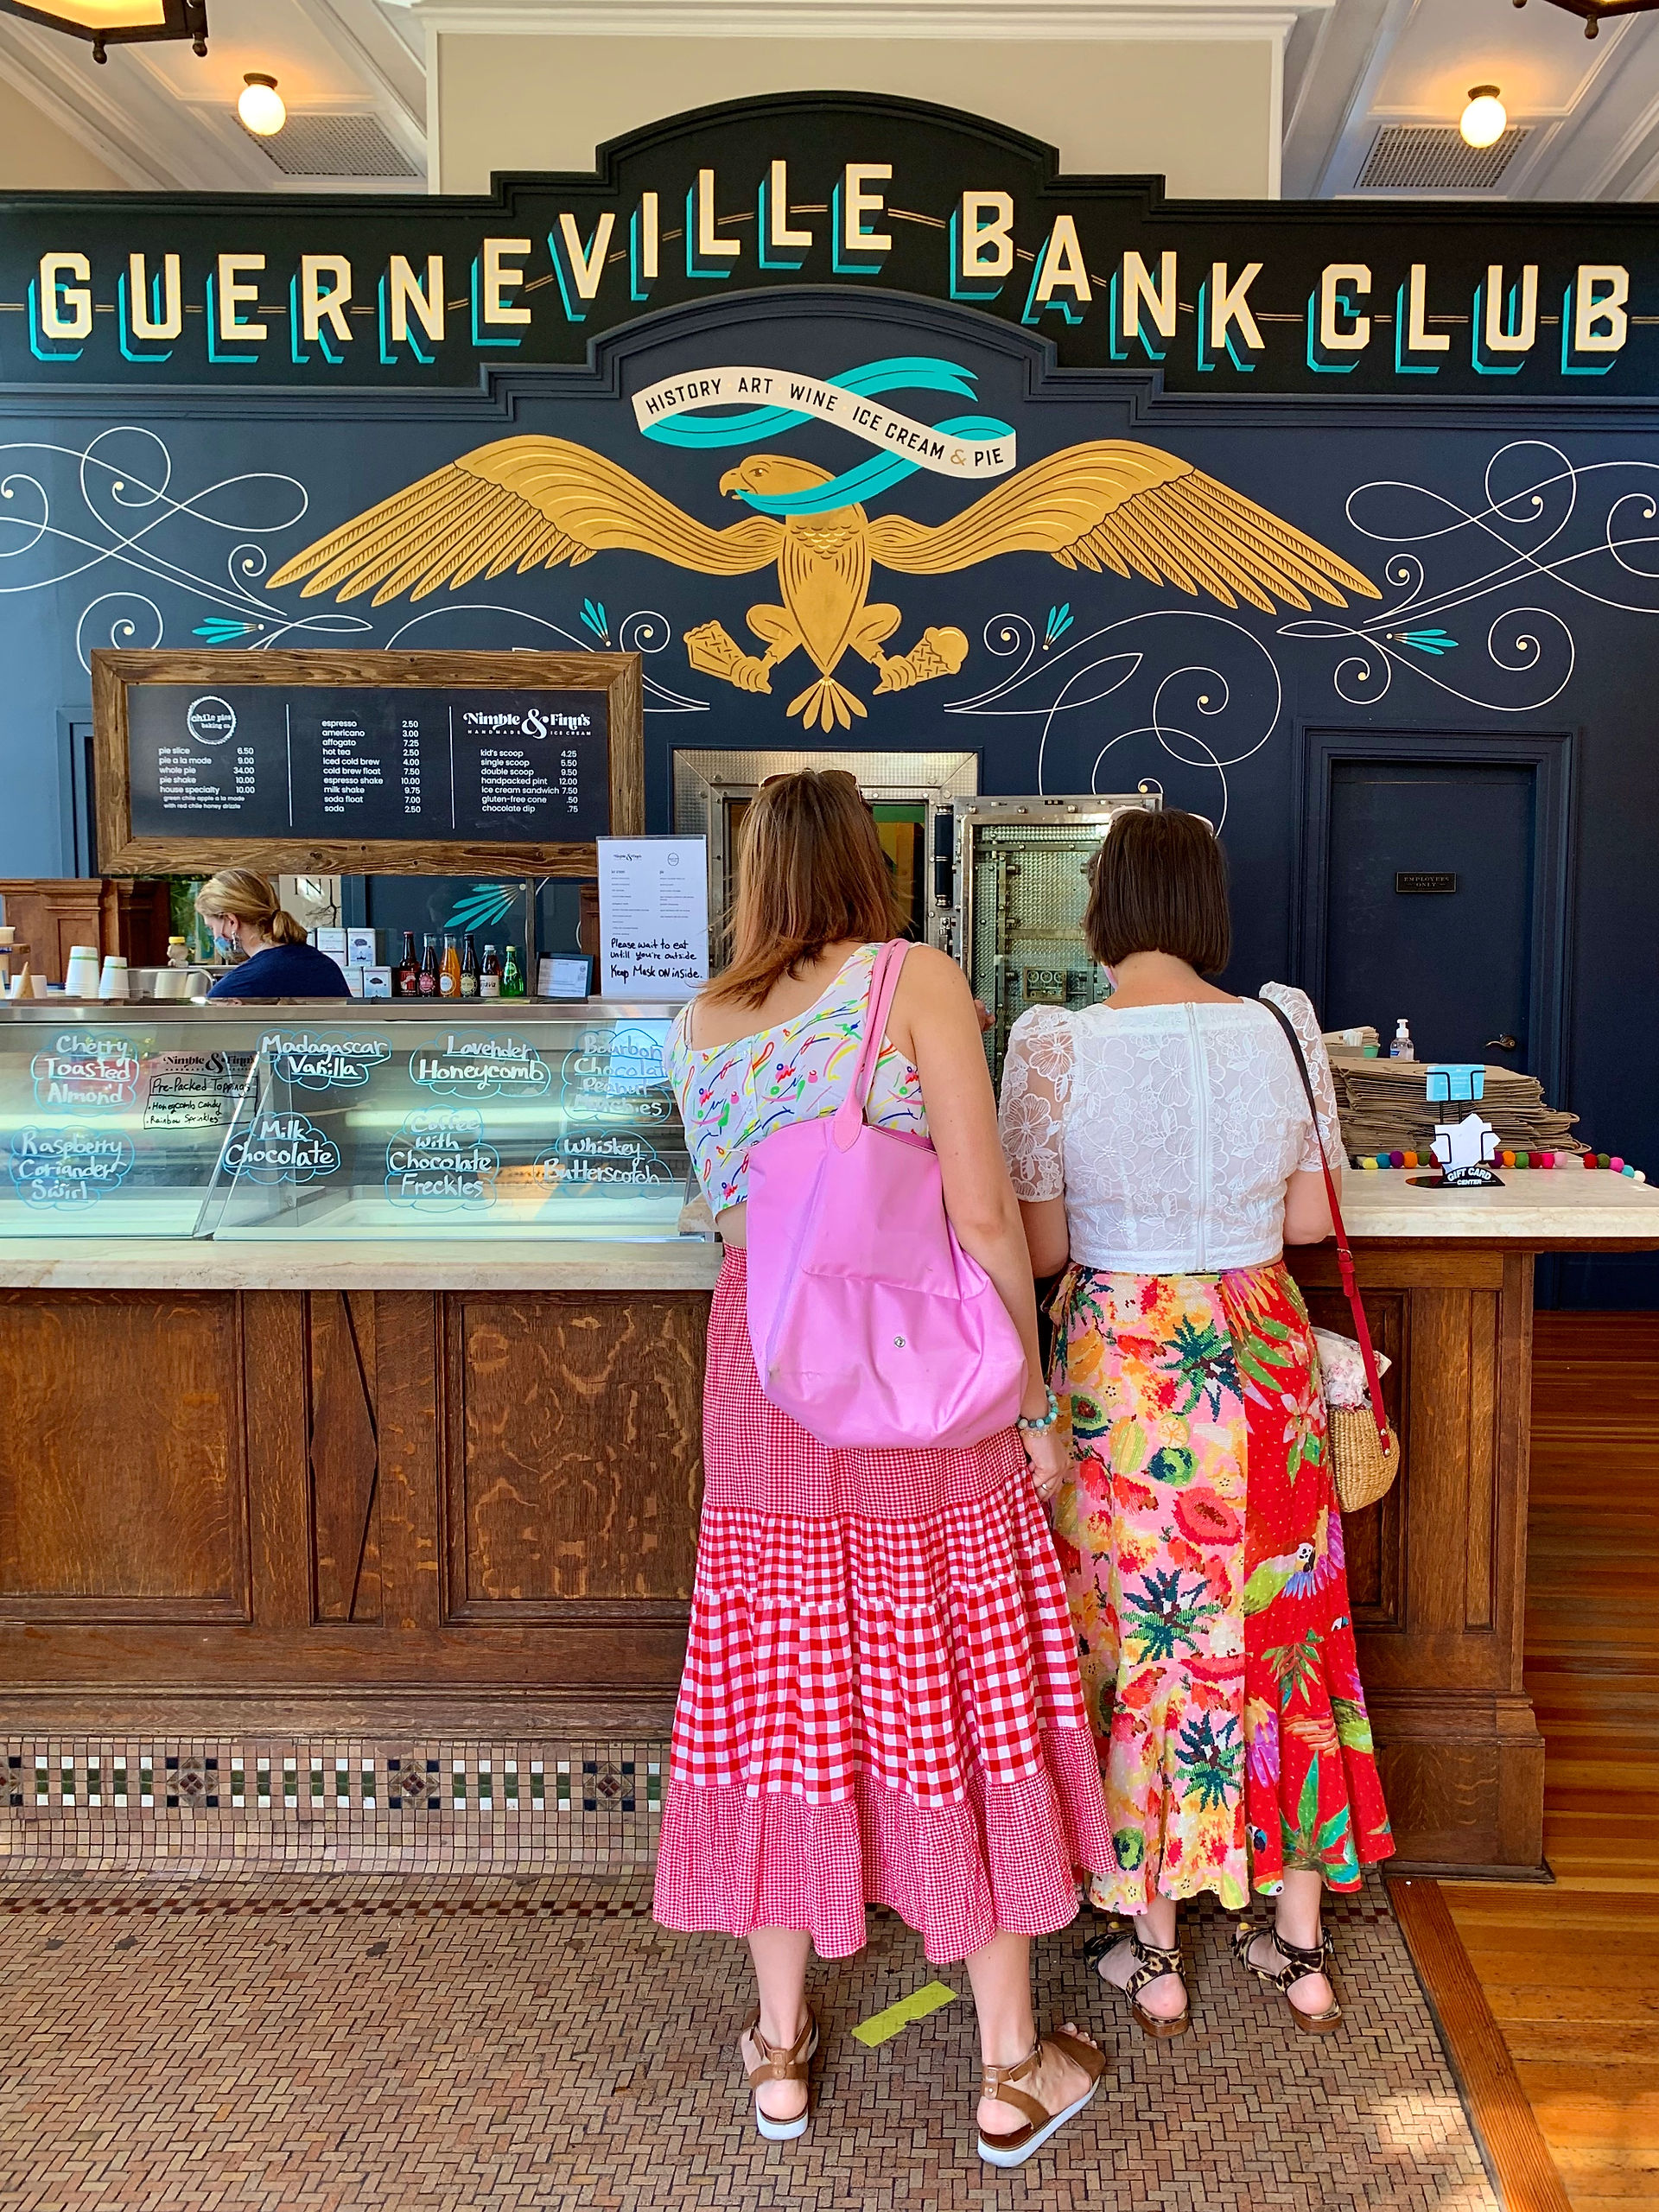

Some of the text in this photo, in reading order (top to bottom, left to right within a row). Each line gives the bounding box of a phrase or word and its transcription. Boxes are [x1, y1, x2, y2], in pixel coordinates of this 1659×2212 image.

[39, 160, 1630, 353] GUERNEVILLE BANK CLUB
[645, 377, 1004, 467] HISTORY ART WINE ICE CREAM & PIE
[321, 721, 358, 729] espresso
[462, 708, 591, 740] Nimble & Finn's
[158, 747, 171, 756] pie
[172, 747, 190, 755] slice
[322, 739, 357, 748] affogato
[158, 757, 171, 766] pie
[480, 759, 505, 767] single
[499, 750, 524, 759] scoop
[159, 776, 173, 785] pie
[183, 766, 197, 776] pie
[323, 777, 359, 785] espresso
[510, 769, 534, 778] scoop
[185, 785, 220, 795] specialty
[481, 777, 531, 786] handpacked
[532, 778, 548, 786] pint
[522, 786, 560, 795] sandwich
[481, 796, 525, 804] gluten-free
[522, 805, 536, 814] dip
[611, 938, 689, 949] Please wait to eat
[610, 950, 696, 961] untill you're outside
[610, 964, 629, 985] Keep
[632, 964, 656, 978] Mask
[658, 968, 671, 978] ON
[55, 1035, 128, 1066] Cherry
[261, 1034, 387, 1065] Madagascar
[447, 1035, 532, 1059] Lavender
[583, 1034, 664, 1059] Bourbon
[44, 1058, 131, 1080] Toasted
[163, 1055, 206, 1068] Nimble
[205, 1053, 225, 1073] &
[288, 1056, 358, 1078] Vanilla
[574, 1057, 669, 1077] Chocolat
[419, 1058, 544, 1090] Honeycomb
[48, 1083, 124, 1105] Almond
[152, 1077, 207, 1094] Pre-Packed
[582, 1077, 648, 1097] Peanut
[151, 1099, 223, 1116] Honeycomb Candy
[150, 1113, 219, 1125] Rainbow Sprinkles
[410, 1114, 480, 1134] Coffee
[260, 1120, 306, 1141] Milk
[22, 1130, 124, 1170] Raspberry
[415, 1133, 460, 1149] with
[564, 1137, 645, 1163] Whiskey
[225, 1141, 335, 1166] Chocolate
[389, 1148, 493, 1172] Chocolate
[19, 1156, 112, 1179] Coriander
[543, 1158, 660, 1185] Butterscotch
[1447, 1167, 1491, 1182] GIFT CARD
[32, 1179, 88, 1199] Swirl
[401, 1173, 484, 1198] Freckles
[1456, 1179, 1483, 1187] CENTER
